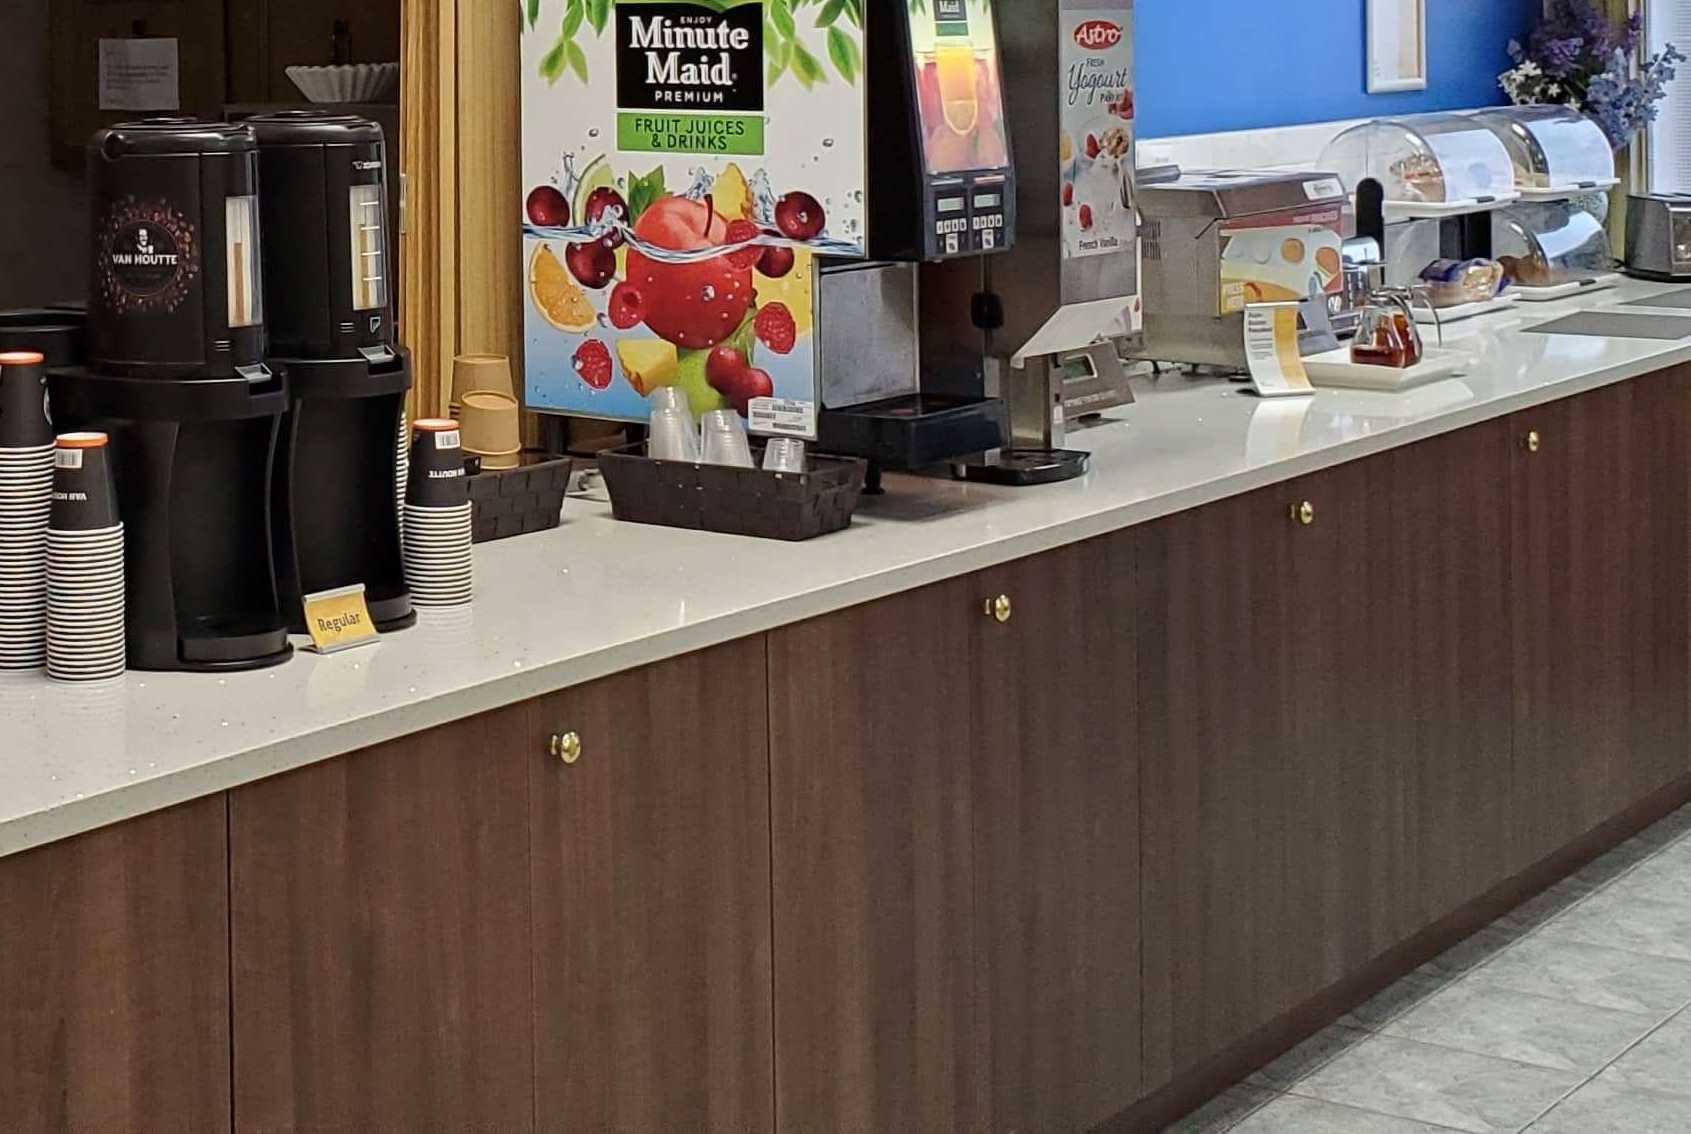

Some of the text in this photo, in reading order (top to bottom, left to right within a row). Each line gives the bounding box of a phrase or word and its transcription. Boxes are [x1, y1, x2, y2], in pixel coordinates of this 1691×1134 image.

[628, 16, 749, 50] Minute
[1075, 25, 1122, 45] Astro
[644, 51, 733, 86] Maid
[1068, 63, 1128, 105] Yogourt
[655, 90, 724, 103] PREMIUM
[635, 118, 745, 136] FRUIT JUICES
[651, 134, 728, 151] & DRINKS
[112, 254, 178, 265] VAN HOUTTE
[317, 612, 361, 634] Regular
